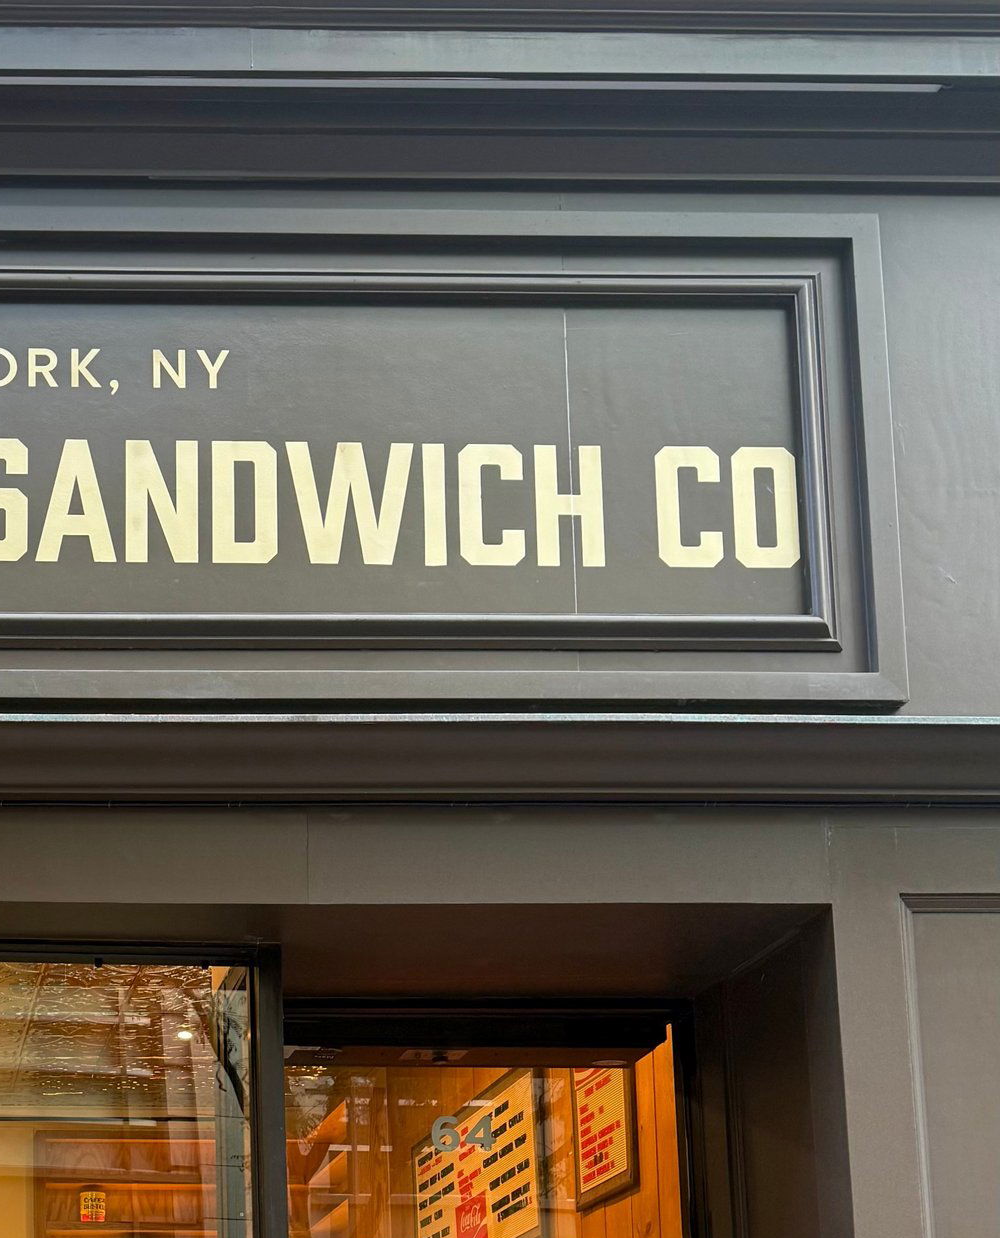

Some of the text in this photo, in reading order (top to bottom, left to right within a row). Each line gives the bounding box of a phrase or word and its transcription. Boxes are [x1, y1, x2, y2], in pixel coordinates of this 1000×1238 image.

[151, 348, 231, 390] NY
[654, 445, 802, 569] CO
[431, 1115, 497, 1152] 64
